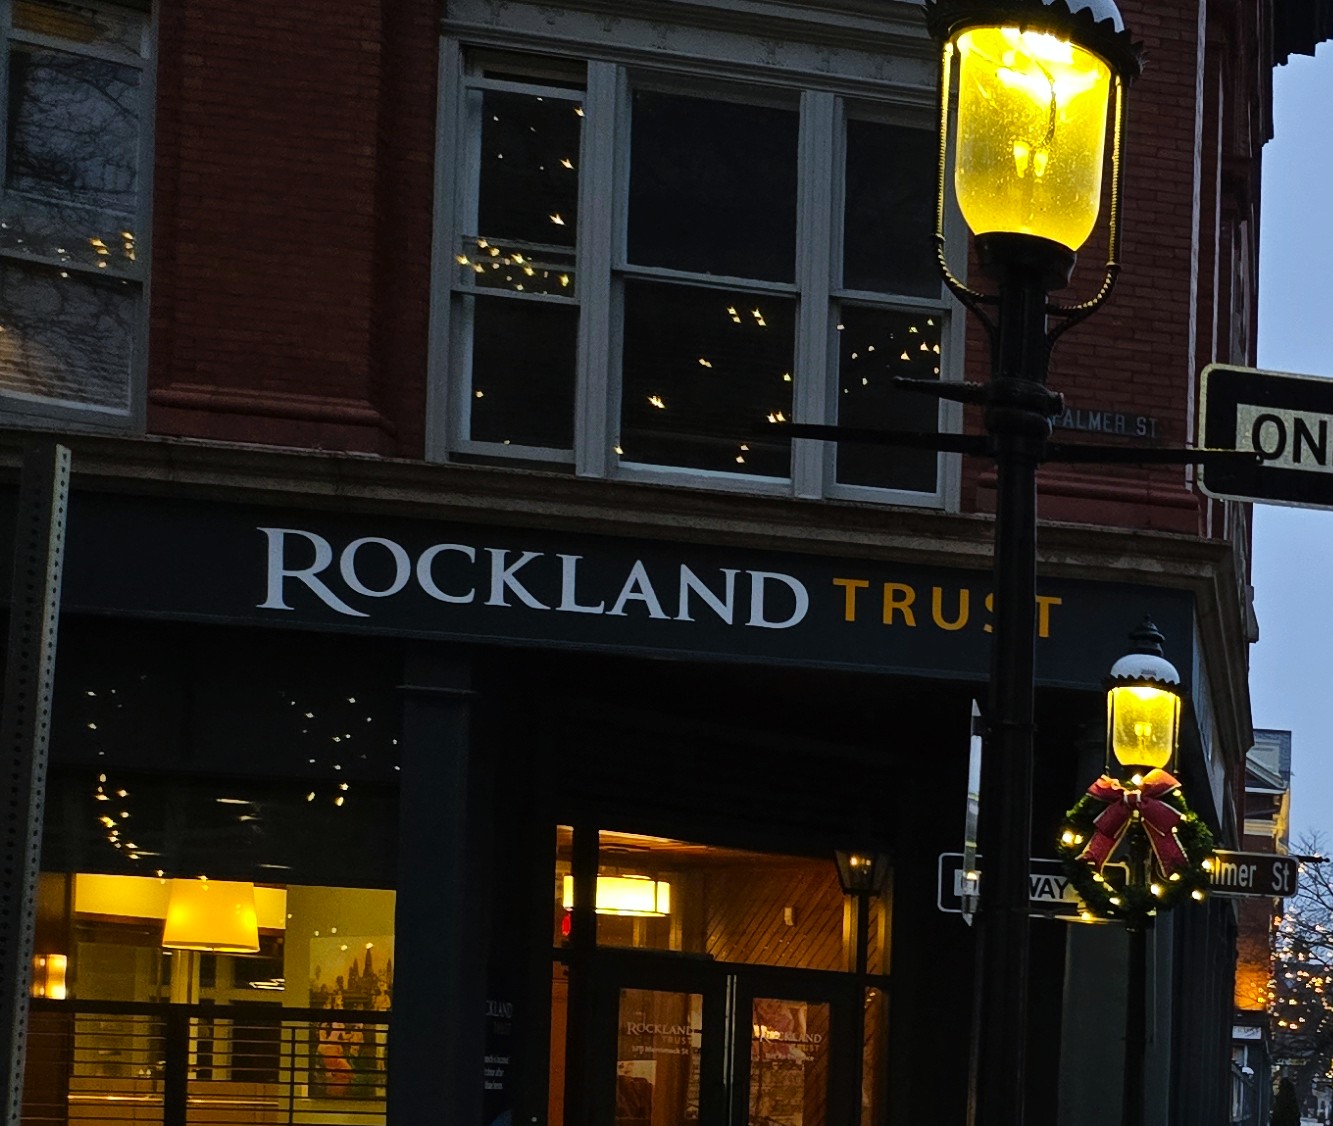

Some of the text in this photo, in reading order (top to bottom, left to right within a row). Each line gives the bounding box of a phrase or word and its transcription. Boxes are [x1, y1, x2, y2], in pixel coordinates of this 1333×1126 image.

[1136, 416, 1159, 438] ST
[256, 526, 810, 630] ROCKLAND
[1210, 856, 1290, 892] lmer St
